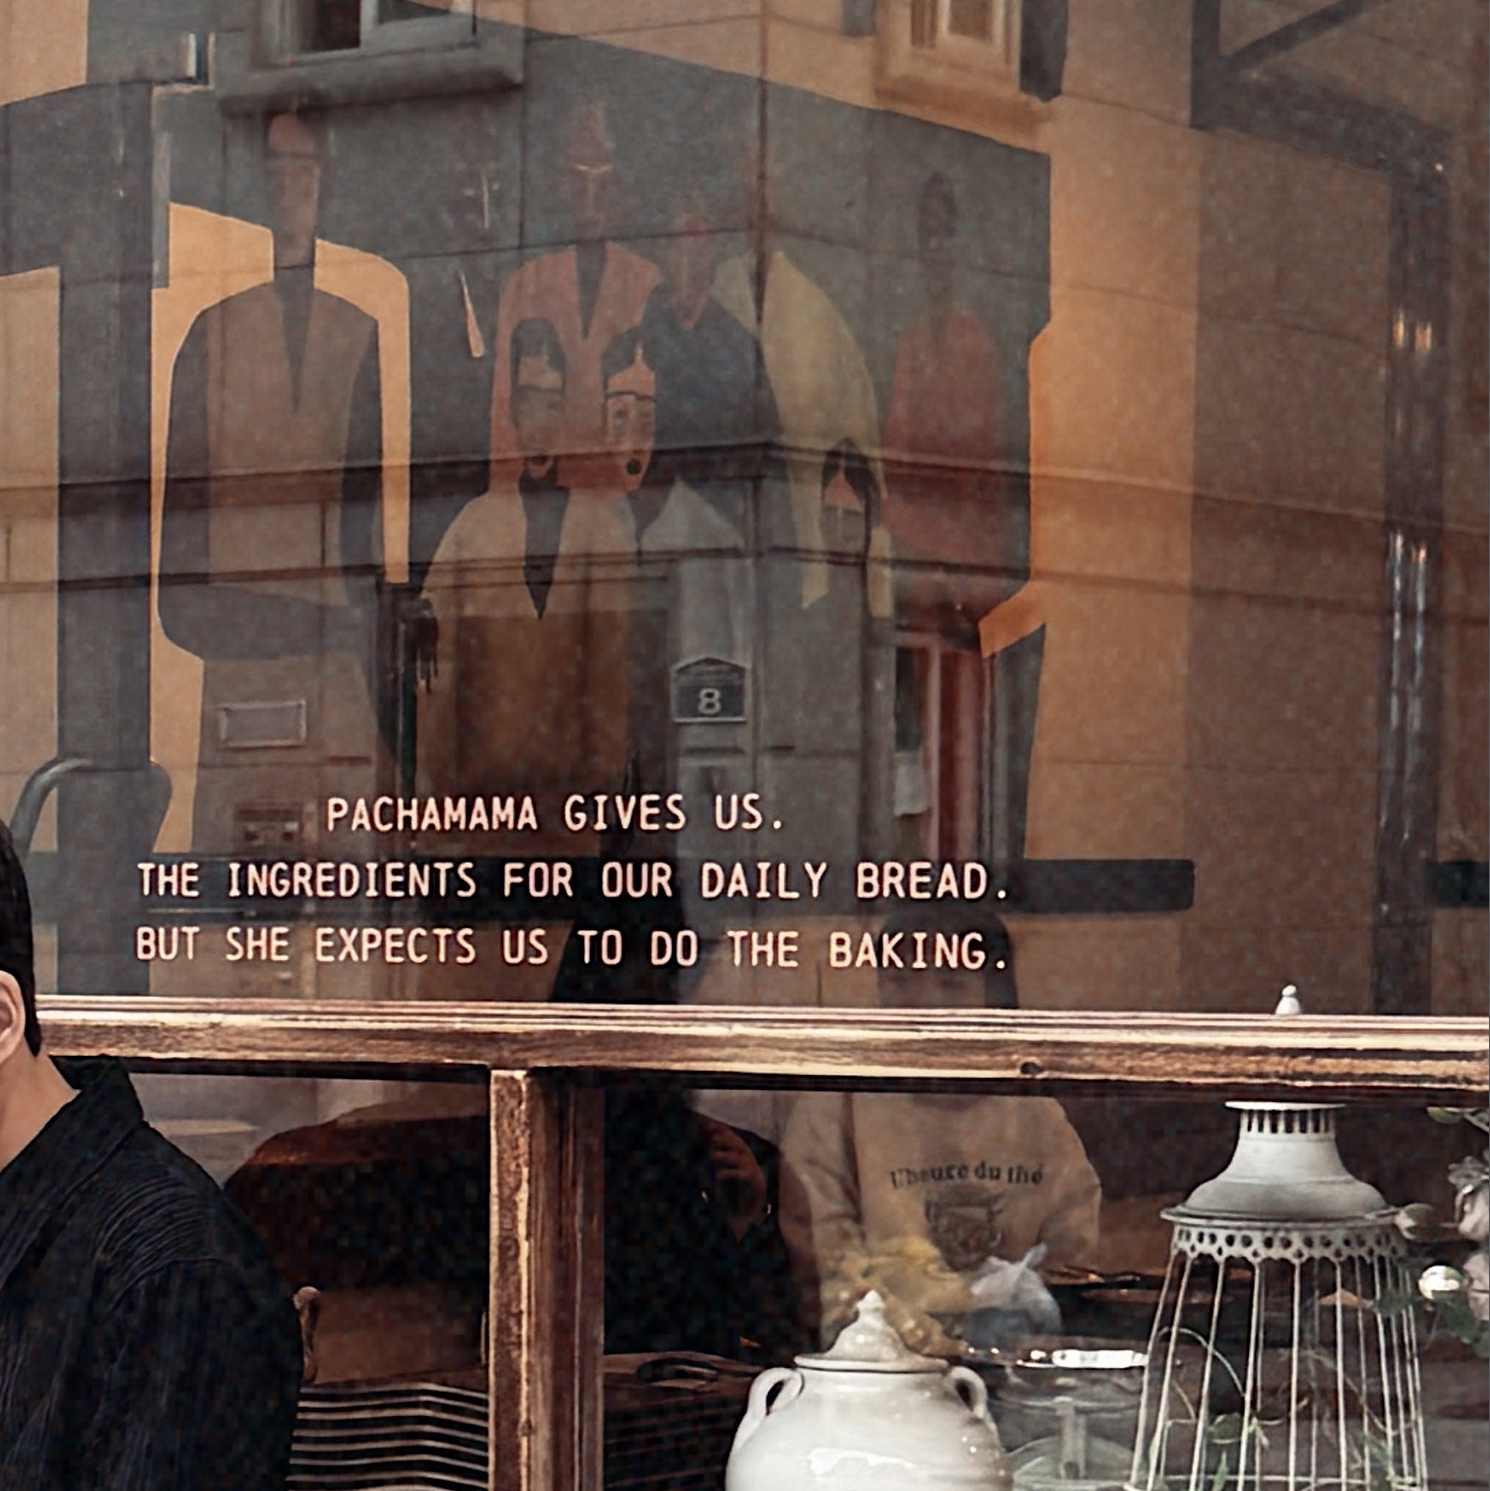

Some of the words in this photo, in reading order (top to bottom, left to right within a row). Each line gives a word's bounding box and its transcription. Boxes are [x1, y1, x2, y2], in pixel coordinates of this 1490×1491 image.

[328, 796, 537, 831] PACHAMAMA
[564, 793, 686, 831] GIVES
[715, 793, 782, 830] US.
[137, 862, 199, 897] THE
[229, 862, 476, 897] INGREDIENTS
[504, 862, 573, 897] FOR
[602, 861, 672, 898] OUR
[702, 862, 827, 899] DAILY
[857, 861, 1006, 899] BREAD.
[137, 926, 200, 961] BUT
[226, 926, 289, 961] SHE
[316, 927, 475, 963] EXPECTS
[504, 928, 548, 964] US
[577, 929, 622, 965] TO
[651, 930, 697, 966] DO
[727, 930, 799, 968] THE
[830, 931, 1005, 970] BAKING.
